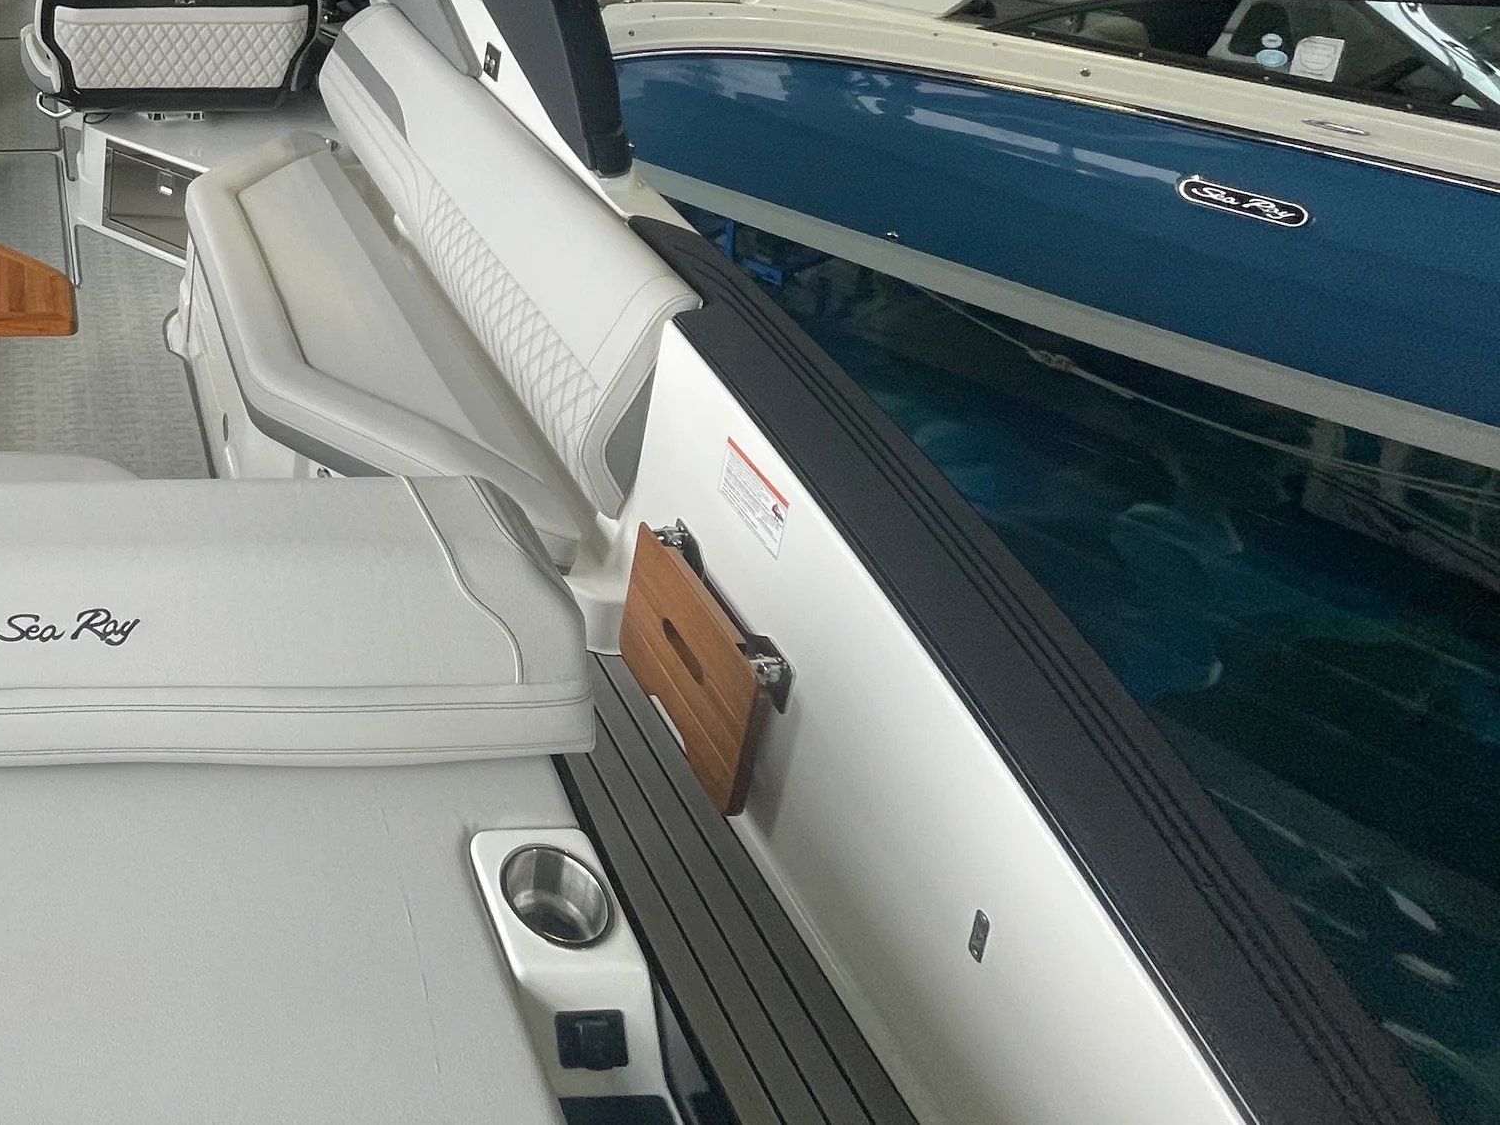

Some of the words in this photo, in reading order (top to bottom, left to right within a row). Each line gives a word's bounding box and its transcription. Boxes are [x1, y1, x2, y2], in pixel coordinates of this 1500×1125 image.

[1191, 185, 1239, 206] Sea
[1241, 197, 1296, 220] Ray
[70, 607, 141, 647] Ray
